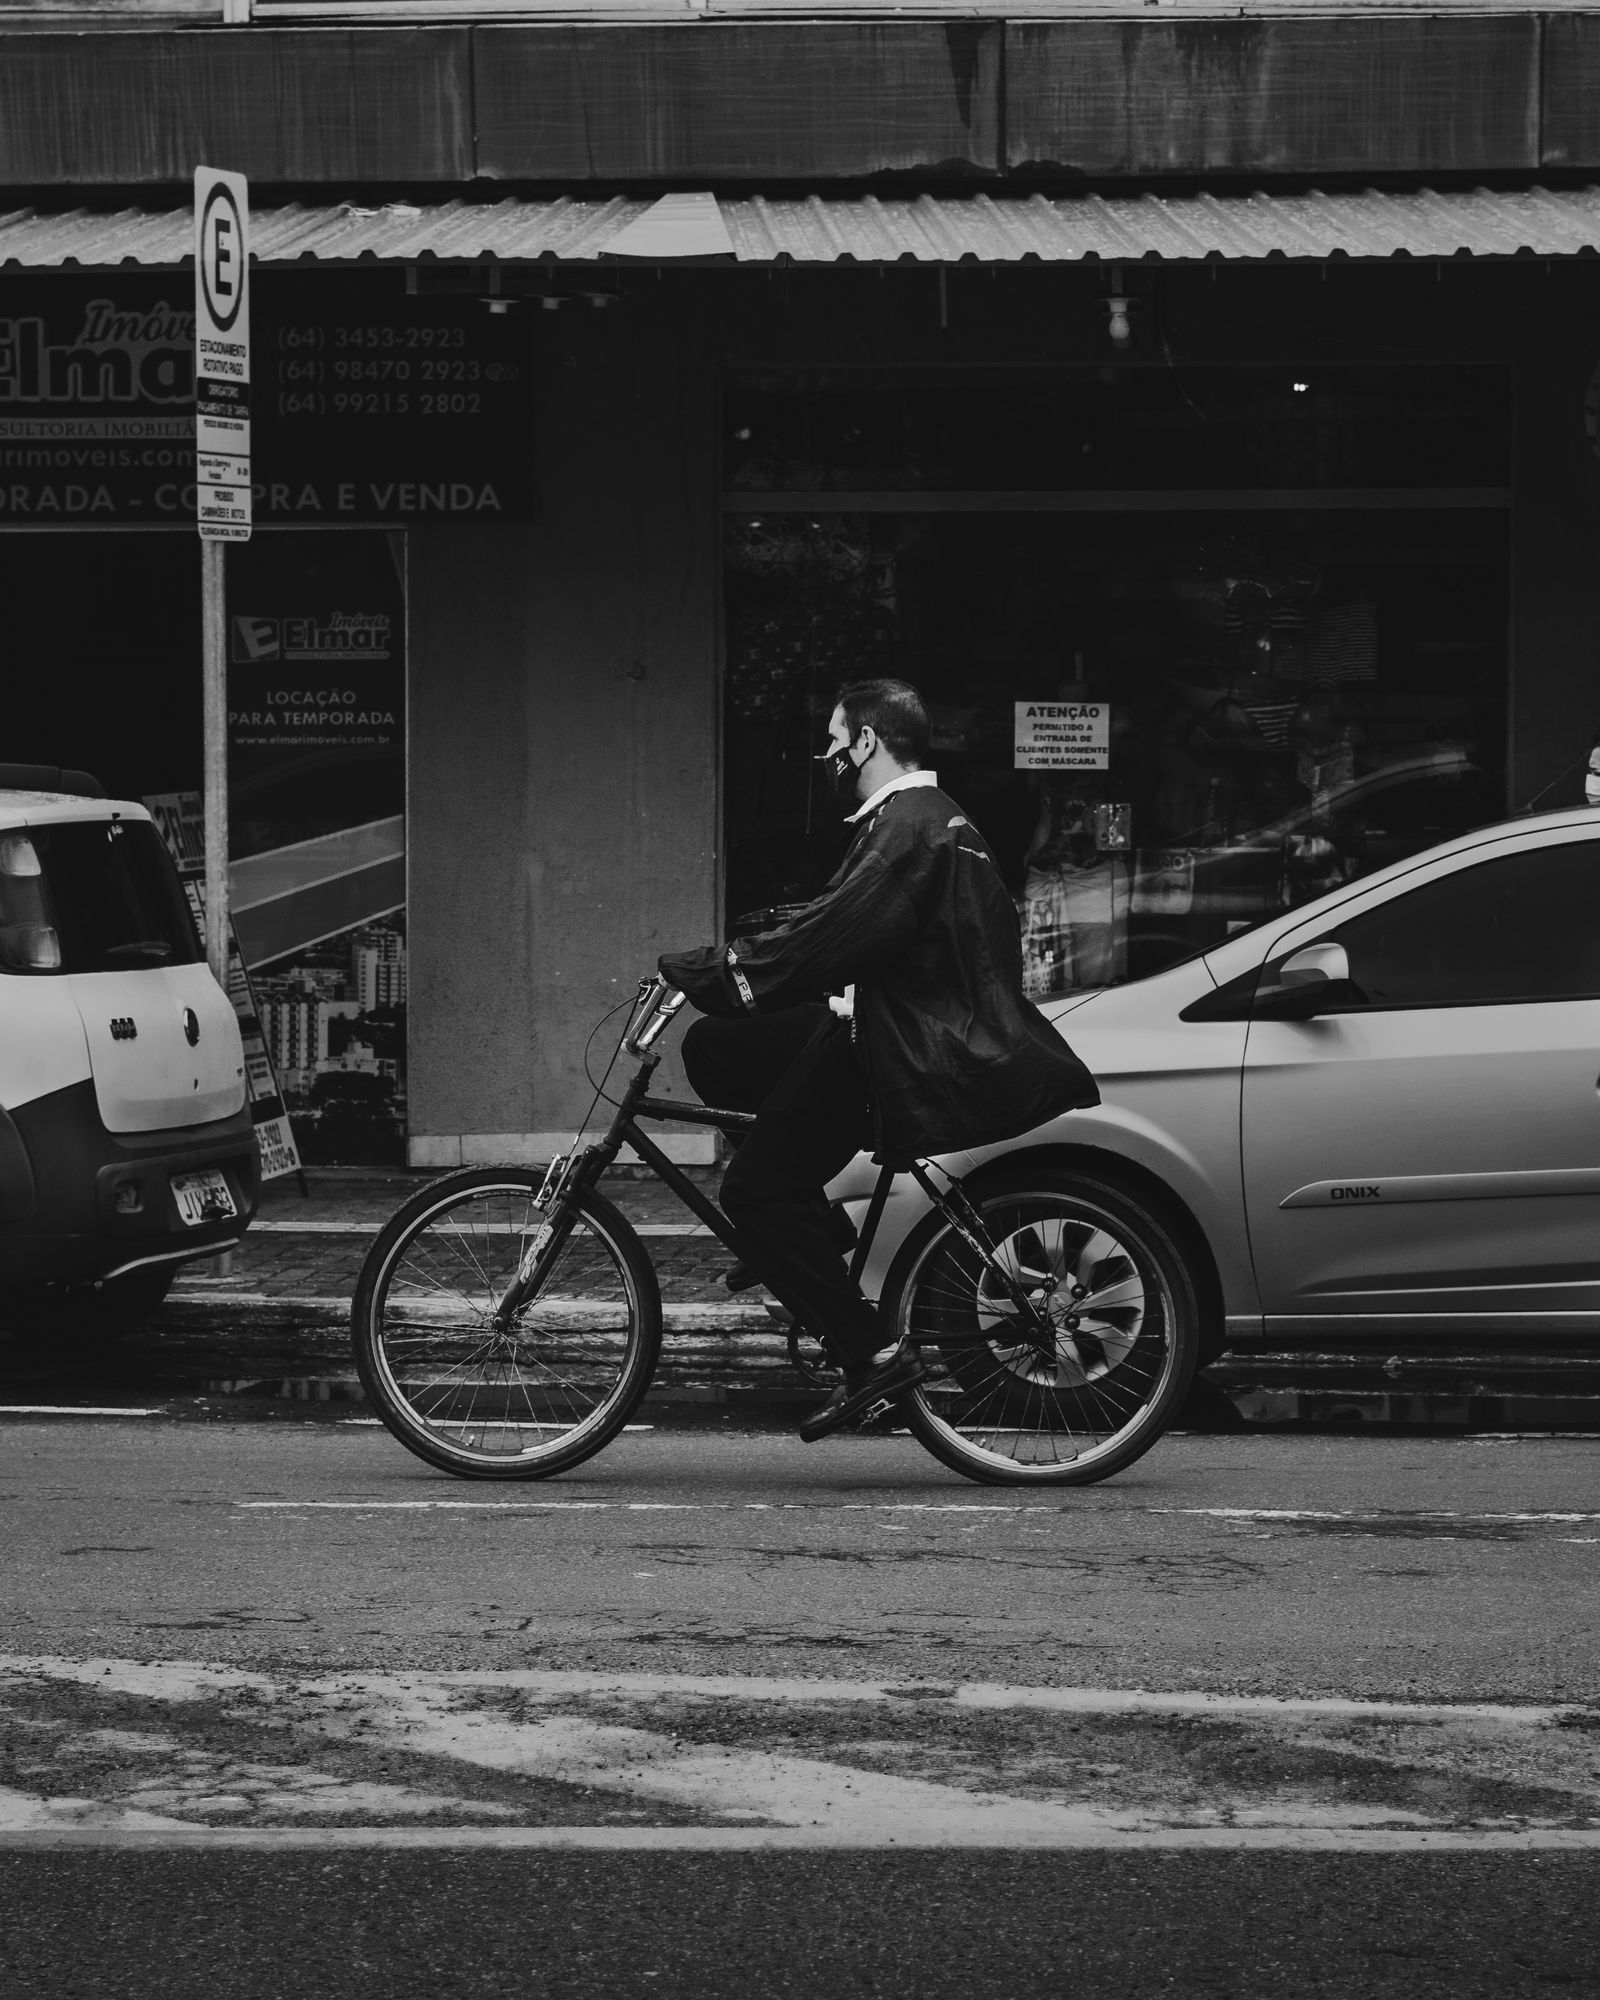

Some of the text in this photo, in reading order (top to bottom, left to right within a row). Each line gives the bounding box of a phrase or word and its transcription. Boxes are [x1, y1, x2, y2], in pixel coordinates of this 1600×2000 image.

[215, 218, 232, 296] E
[278, 326, 465, 350] (64) 3453-2923
[200, 339, 246, 358] ESTACIONAMENTO
[203, 358, 243, 376] ROTATIVO PAGO
[278, 359, 480, 383] (64) 98470 2923
[278, 391, 481, 416] (64) 99215 2802
[0, 449, 195, 467] rimoveis.com
[0, 485, 115, 512] RADA
[155, 484, 322, 511] COPRA
[338, 484, 355, 510] E
[370, 484, 502, 510] VENDA
[283, 618, 391, 650] Elmar
[267, 688, 357, 708] LOCAÇÃO
[229, 712, 395, 725] PARA TEMPORADA
[1027, 705, 1099, 720] ATENÇÃO
[1033, 723, 1084, 731] PERMITIDO
[1331, 1186, 1381, 1199] ONIX
